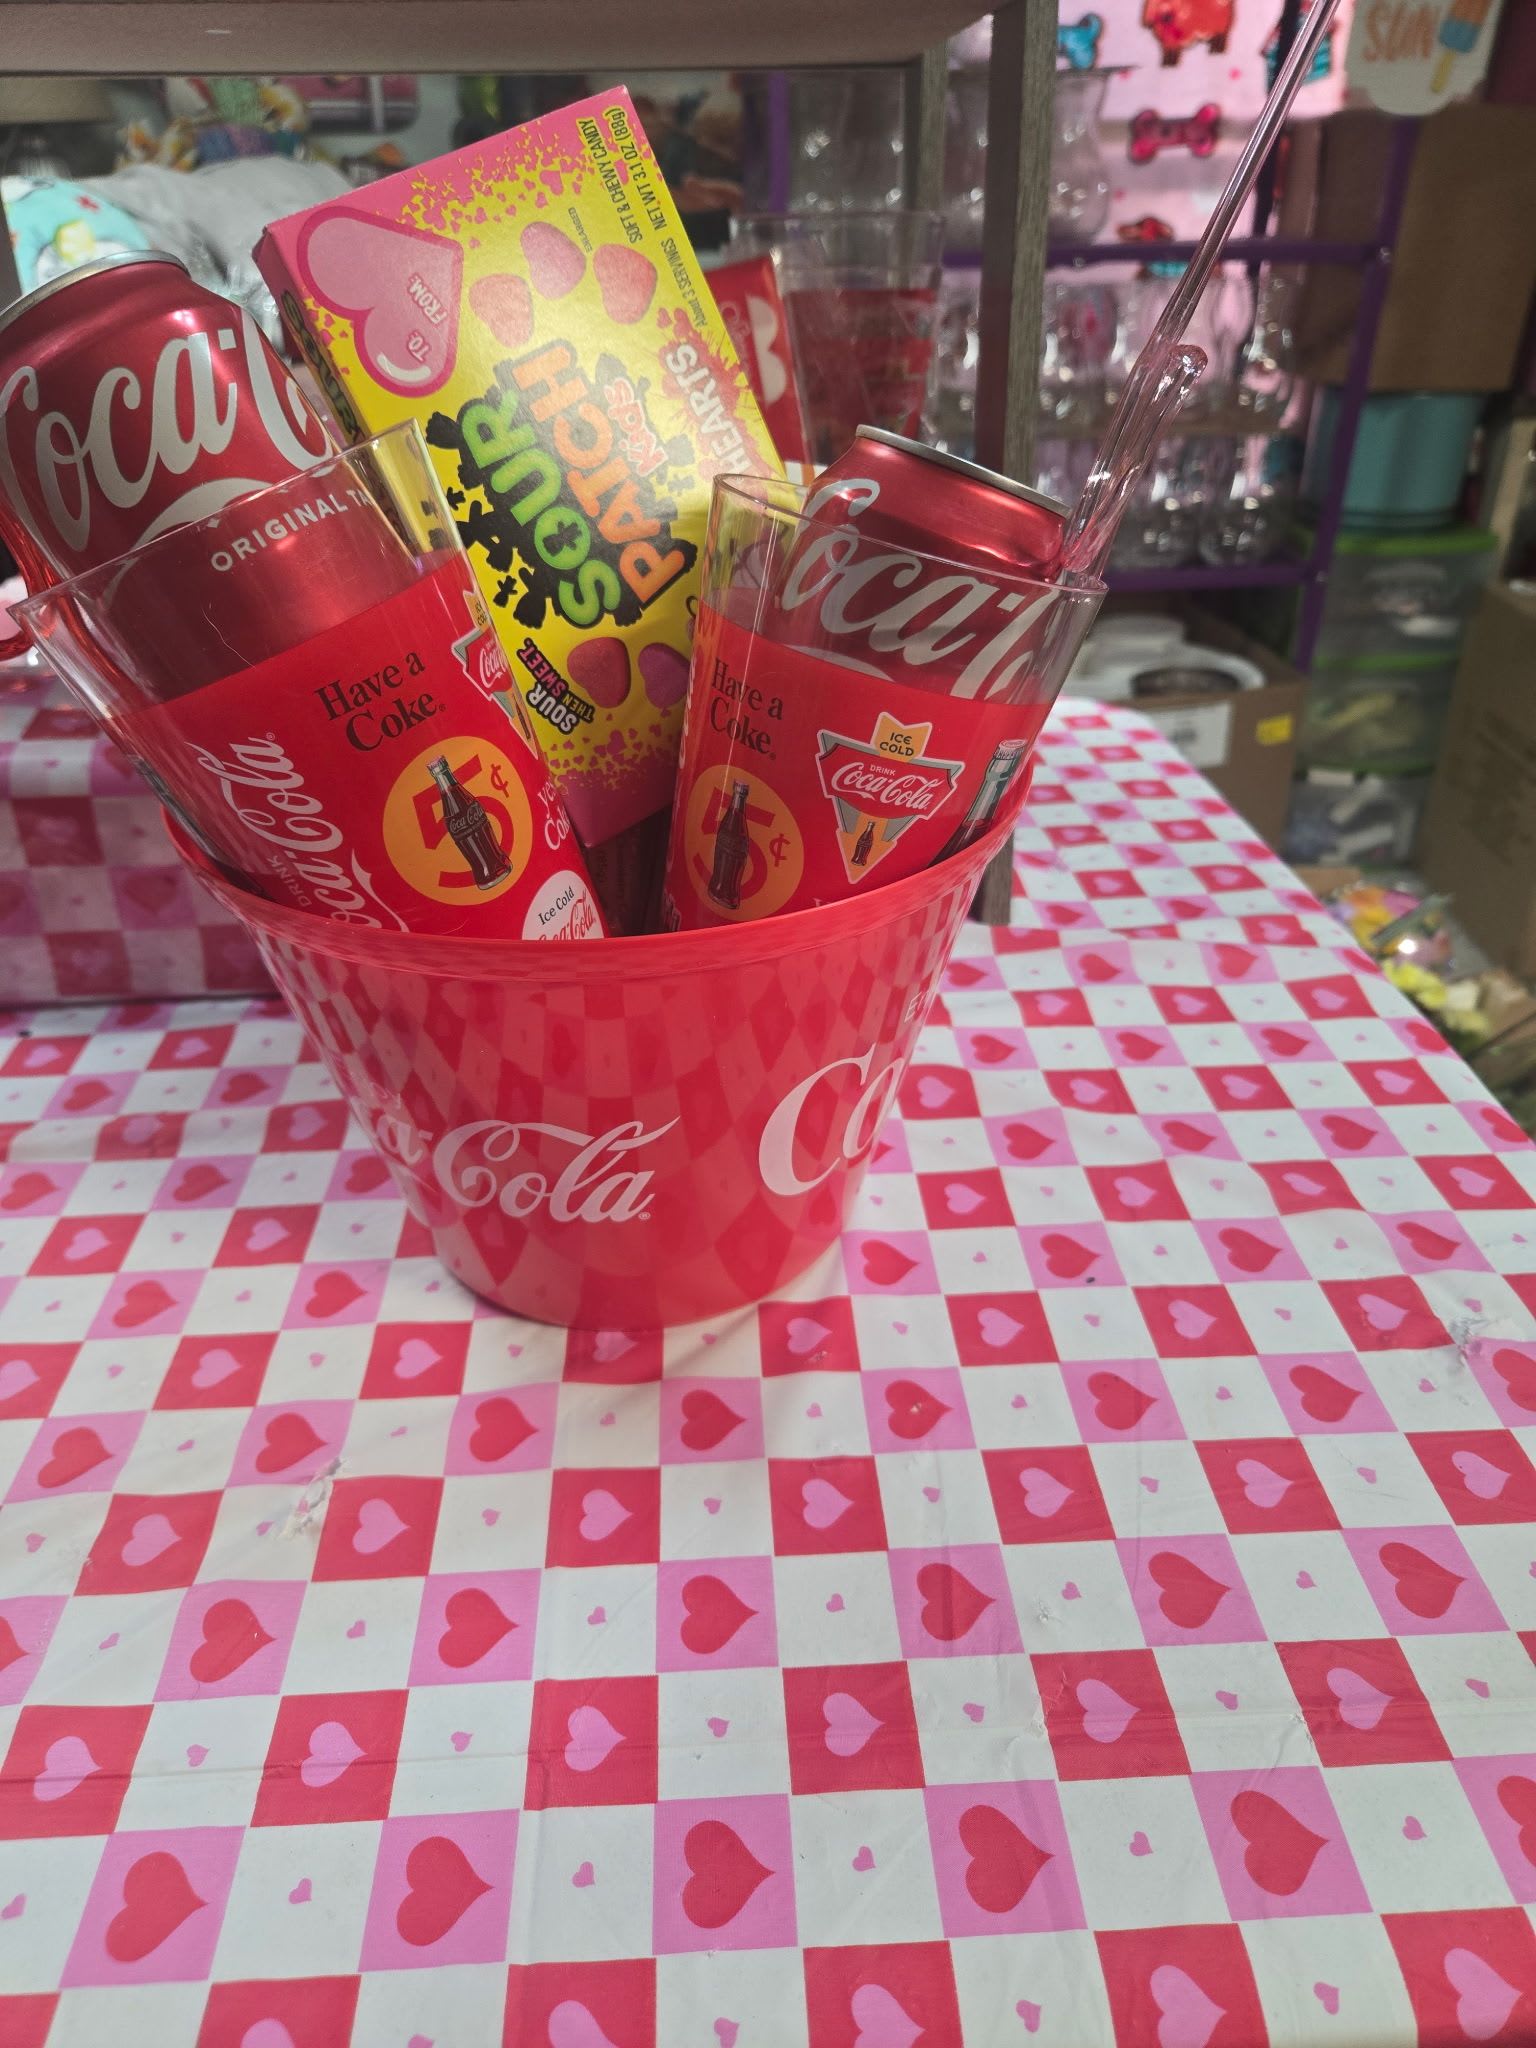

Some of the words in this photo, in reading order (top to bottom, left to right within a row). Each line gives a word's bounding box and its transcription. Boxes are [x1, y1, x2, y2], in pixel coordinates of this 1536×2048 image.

[578, 119, 608, 159] CANDY
[606, 108, 631, 141] (88g)
[621, 142, 638, 161] OZ
[598, 160, 625, 204] CHEWY
[629, 163, 647, 182] 3.1
[617, 202, 631, 214] &
[637, 183, 656, 206] WT
[620, 215, 643, 244] SOFT
[647, 207, 668, 231] NET
[661, 238, 692, 294] SERVINGS
[409, 273, 448, 325] FROM:
[407, 332, 431, 362] TO:
[665, 343, 752, 473] HEARTS
[511, 346, 686, 602] PATCH
[461, 389, 621, 626] SOUR
[210, 492, 348, 573] ORIGINAL
[314, 664, 403, 721] Have
[405, 652, 425, 676] a
[712, 657, 763, 713] Have
[767, 698, 784, 721] a
[528, 683, 577, 733] SOUR
[562, 693, 594, 721] THEN
[879, 741, 914, 757] COLD
[890, 732, 912, 744] ICE
[831, 762, 945, 810] Coca-Cola
[869, 764, 896, 776] DRINK
[538, 907, 556, 925] Ice
[556, 885, 575, 911] Cold
